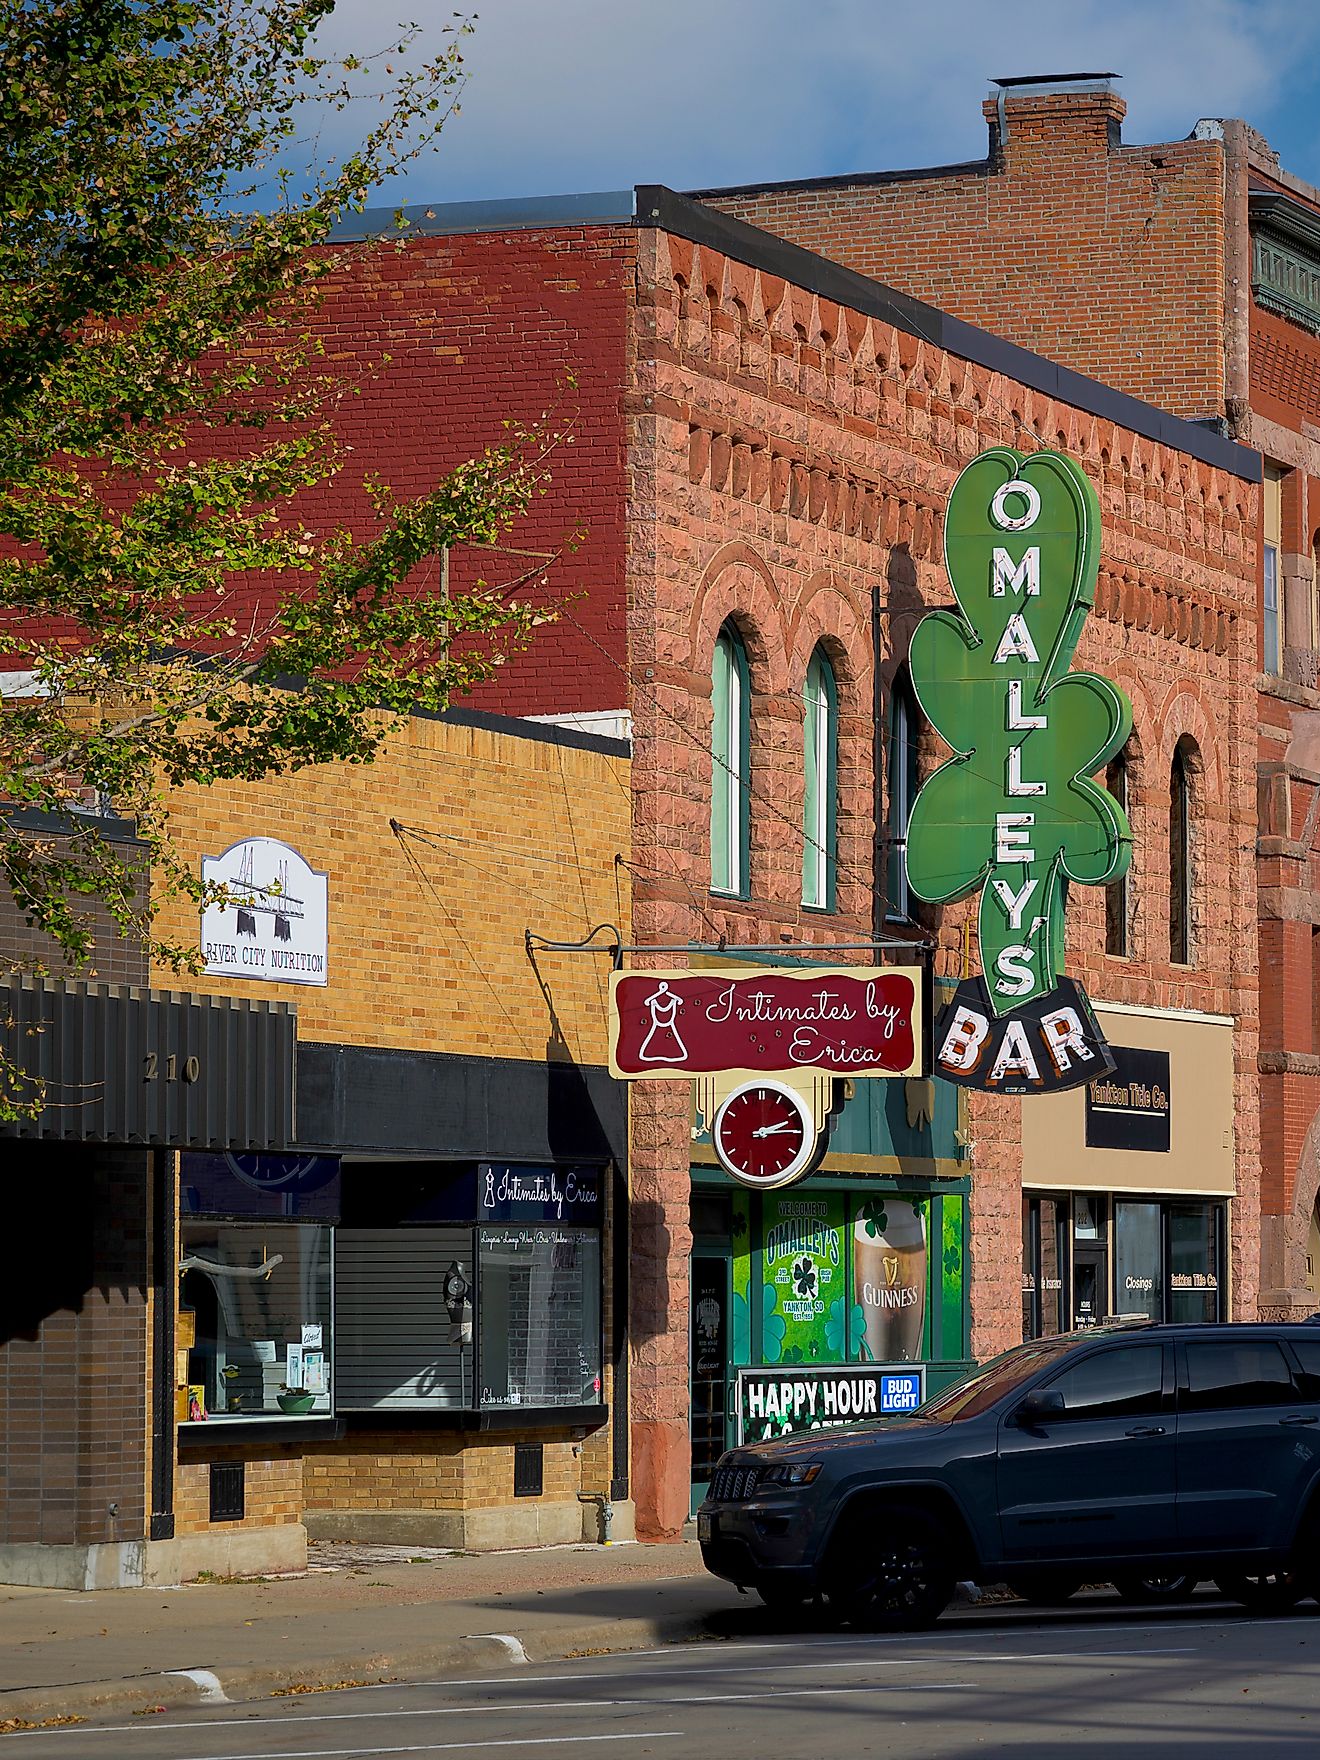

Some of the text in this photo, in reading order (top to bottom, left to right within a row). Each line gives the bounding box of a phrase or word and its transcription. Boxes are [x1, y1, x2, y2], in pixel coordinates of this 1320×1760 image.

[205, 942, 323, 972] RIVER CITY NUTRITION
[705, 981, 900, 1039] Intimates by
[788, 1026, 881, 1064] Erica
[938, 1005, 1095, 1080] BAR
[145, 1052, 200, 1083] 210
[1089, 1080, 1169, 1110] Yankton Title Co.
[497, 1168, 598, 1219] Intimates by Erica
[778, 1201, 828, 1216] WELCOME TO
[766, 1218, 840, 1267] O'MALLEY'S
[863, 1282, 918, 1309] GUINNESS
[1125, 1276, 1153, 1292] Closings
[815, 1301, 824, 1313] SD
[749, 1379, 877, 1418] HAPPY HOUR
[883, 1393, 917, 1409] LIGHT
[888, 1379, 912, 1394] BUD
